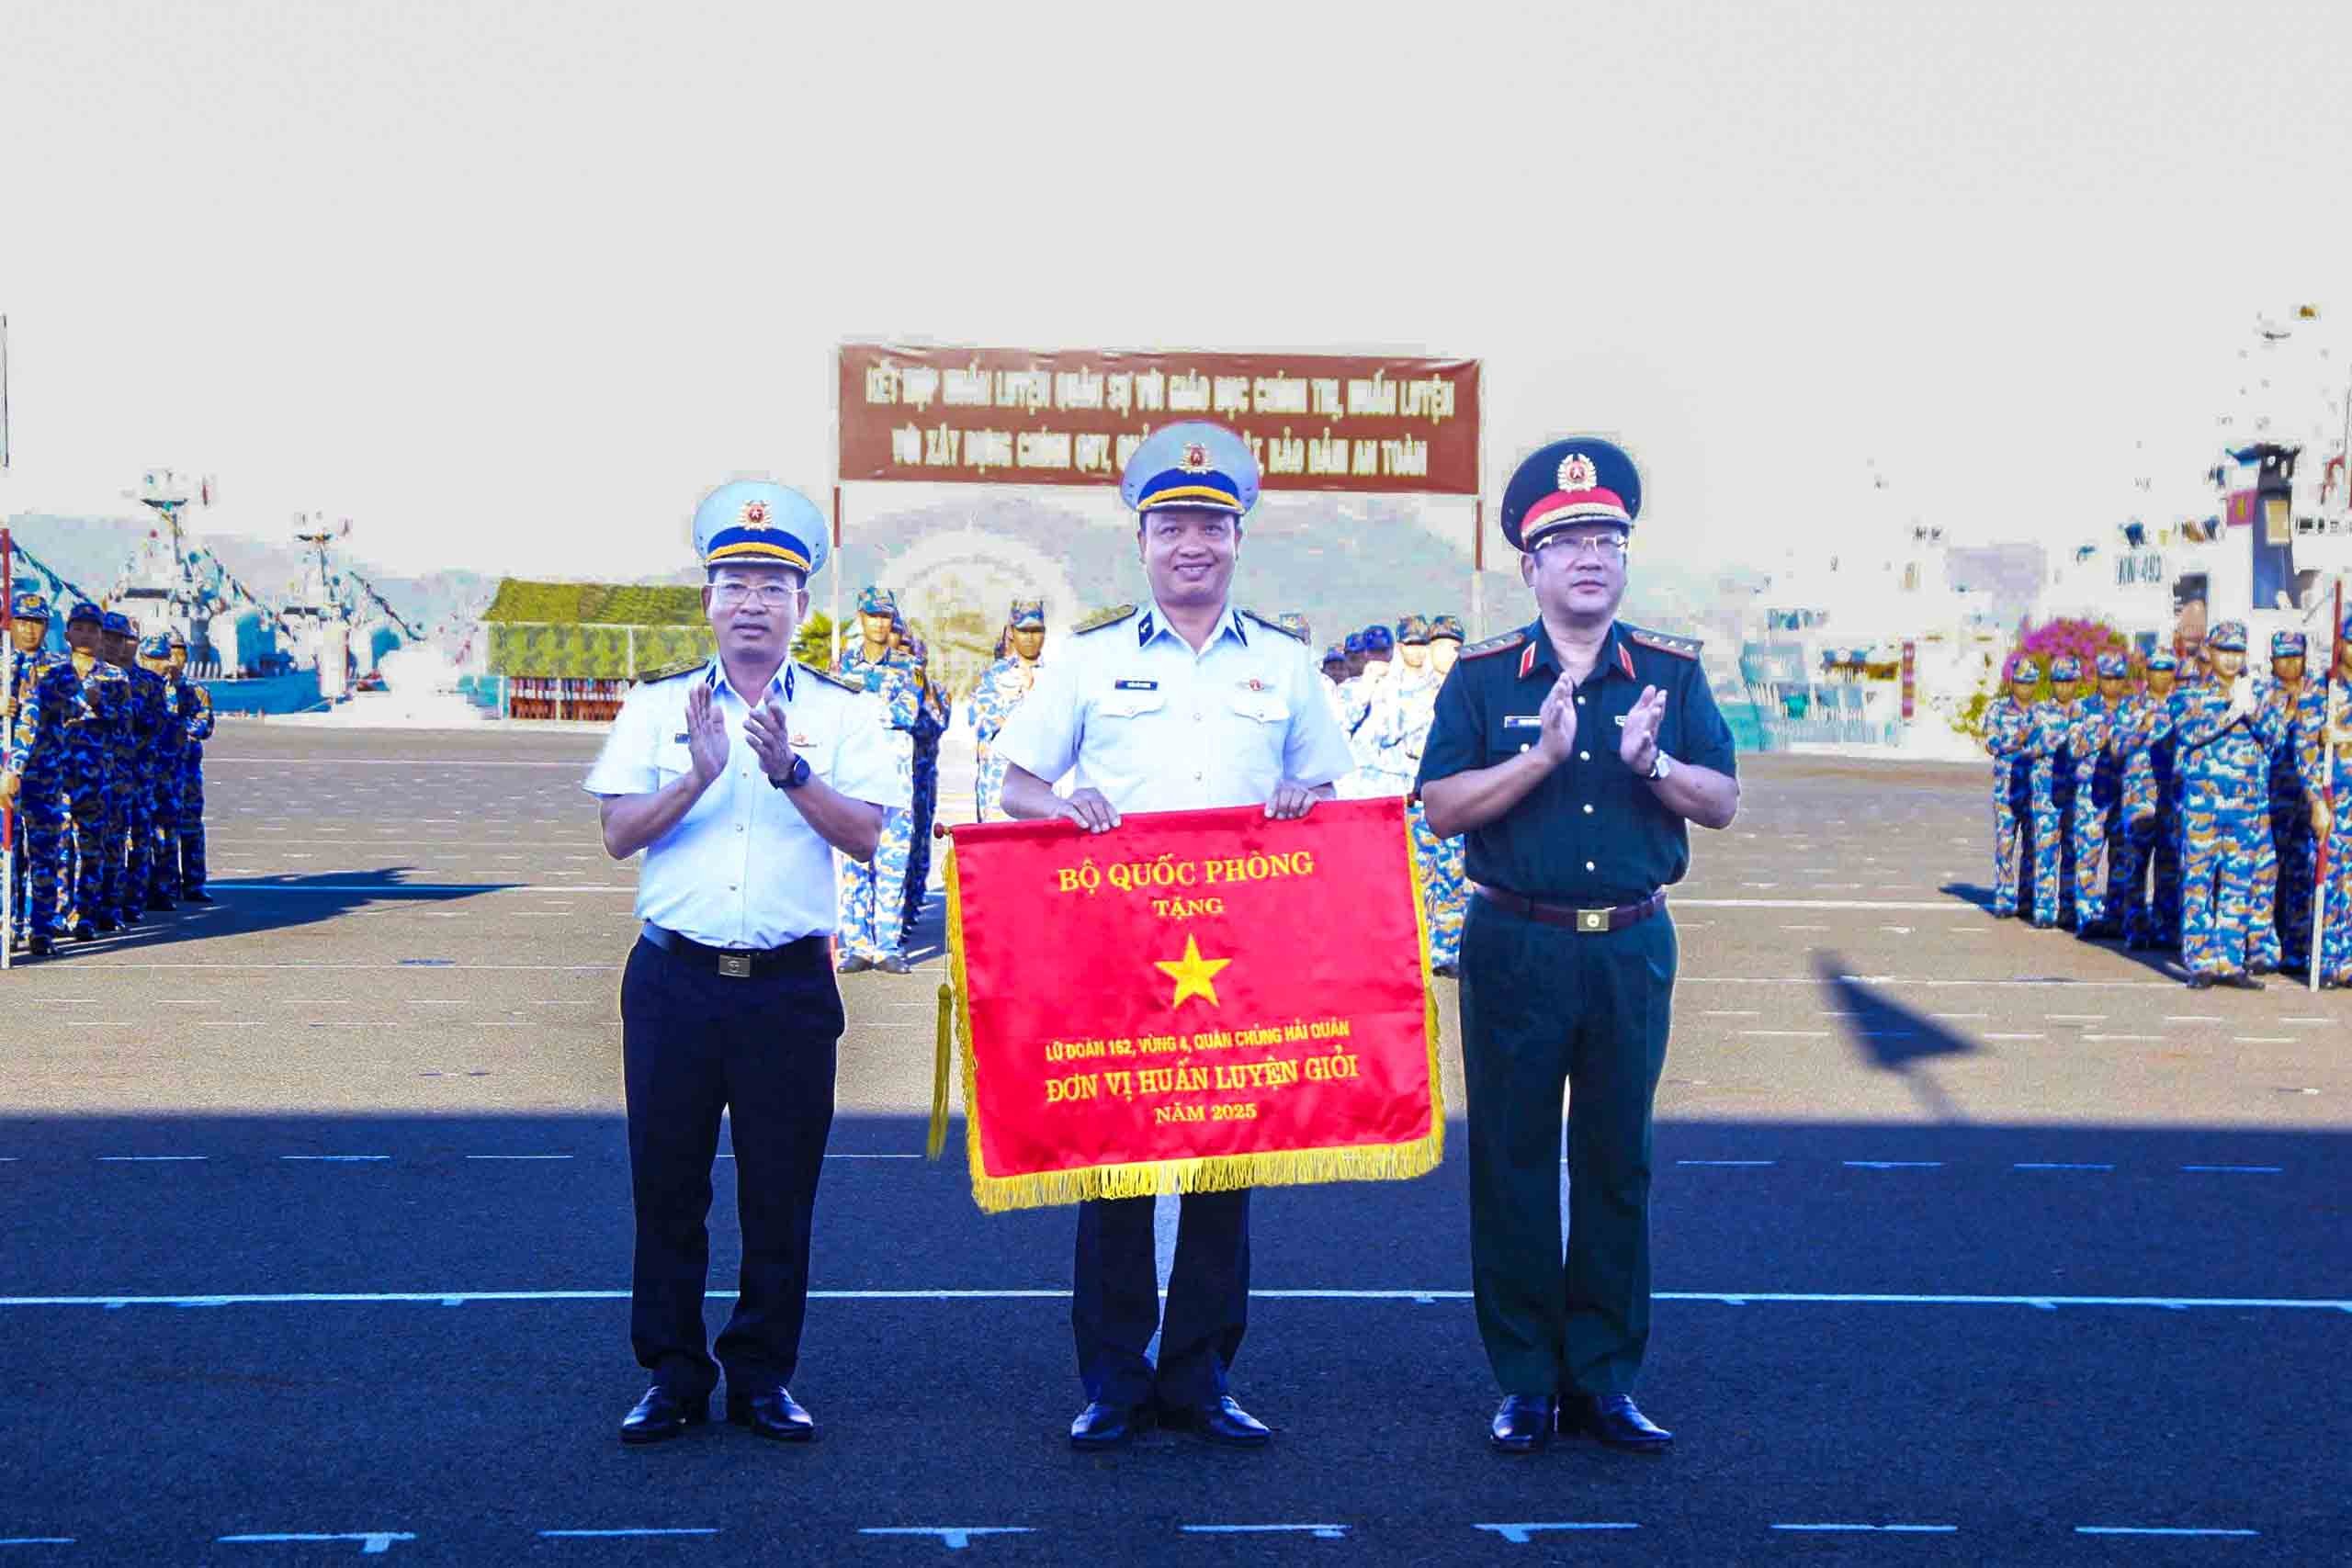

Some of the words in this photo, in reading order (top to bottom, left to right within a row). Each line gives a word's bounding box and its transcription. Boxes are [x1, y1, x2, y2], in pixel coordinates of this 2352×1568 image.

[1058, 859, 1101, 895] BỘ
[1108, 852, 1197, 892] QUỐC
[1204, 850, 1315, 884] PHÒNG
[1152, 896, 1226, 921] TẶNG
[1045, 1040, 1064, 1061] LỮ
[1066, 1037, 1104, 1059] ĐOÀN
[1109, 1038, 1137, 1057] 162,
[1138, 1032, 1177, 1054] VÙNG
[1180, 1034, 1193, 1054] 4,
[1195, 1029, 1232, 1050] QUÂN
[1235, 1022, 1283, 1046] CHỦNG
[1284, 1018, 1308, 1042] HẢI
[1310, 1016, 1350, 1039] QUÂN
[1045, 1072, 1099, 1103] ĐƠN
[1103, 1070, 1133, 1103] VỊ
[1138, 1056, 1209, 1094] HUẤN
[1215, 1055, 1299, 1091] LUYỆN
[1305, 1043, 1359, 1081] GIỎI
[1154, 1101, 1205, 1125] NĂM
[1212, 1102, 1258, 1122] 2025
